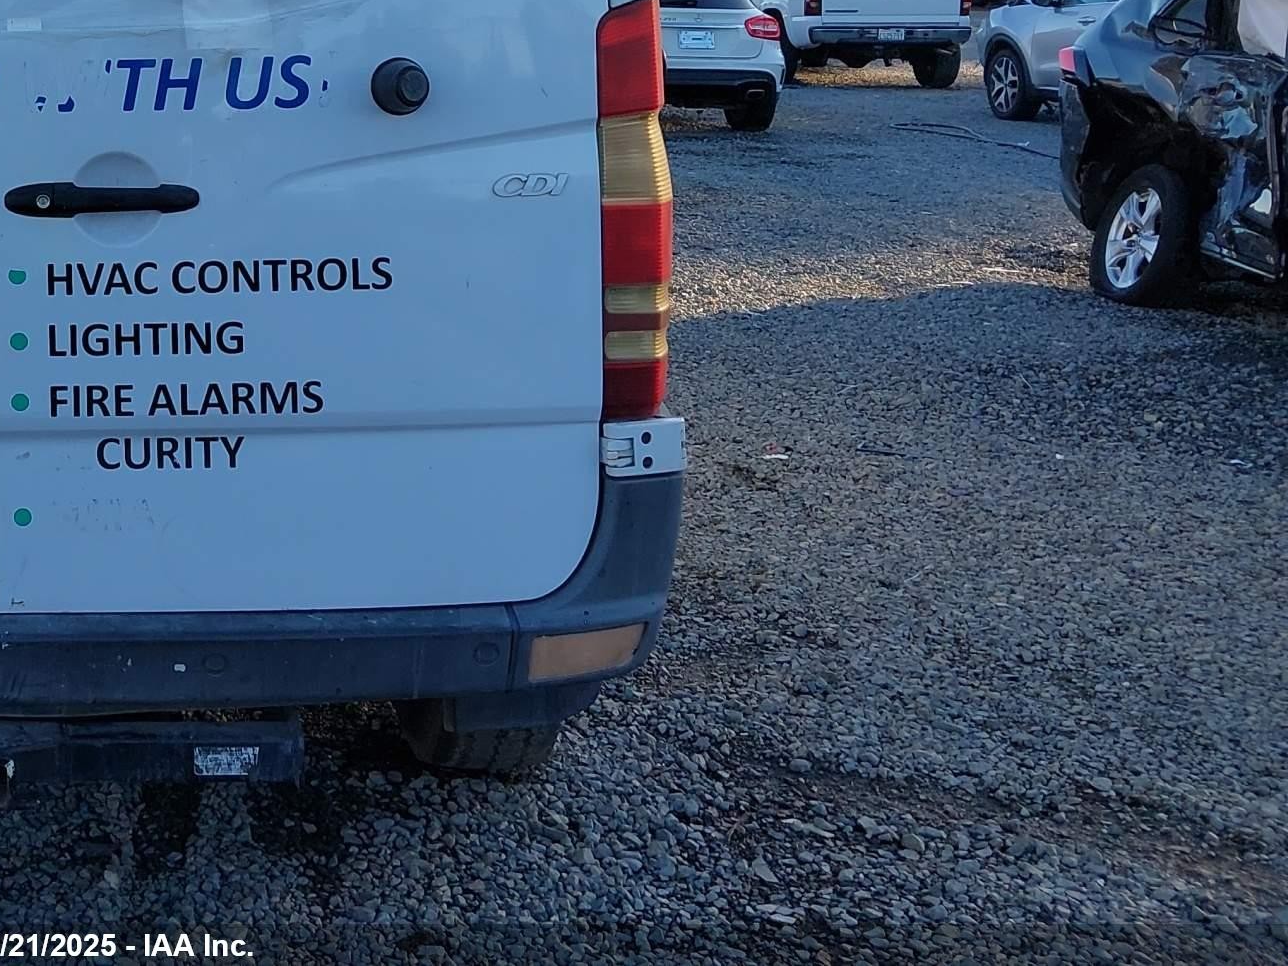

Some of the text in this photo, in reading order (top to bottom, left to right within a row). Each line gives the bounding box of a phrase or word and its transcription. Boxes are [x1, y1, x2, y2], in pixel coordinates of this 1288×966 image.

[491, 172, 569, 198] CDI
[47, 256, 393, 296] HVAC CONTROLS
[48, 321, 245, 357] LIGHTING
[49, 380, 324, 418] FIRE ALARMS
[96, 436, 245, 471] CURITY
